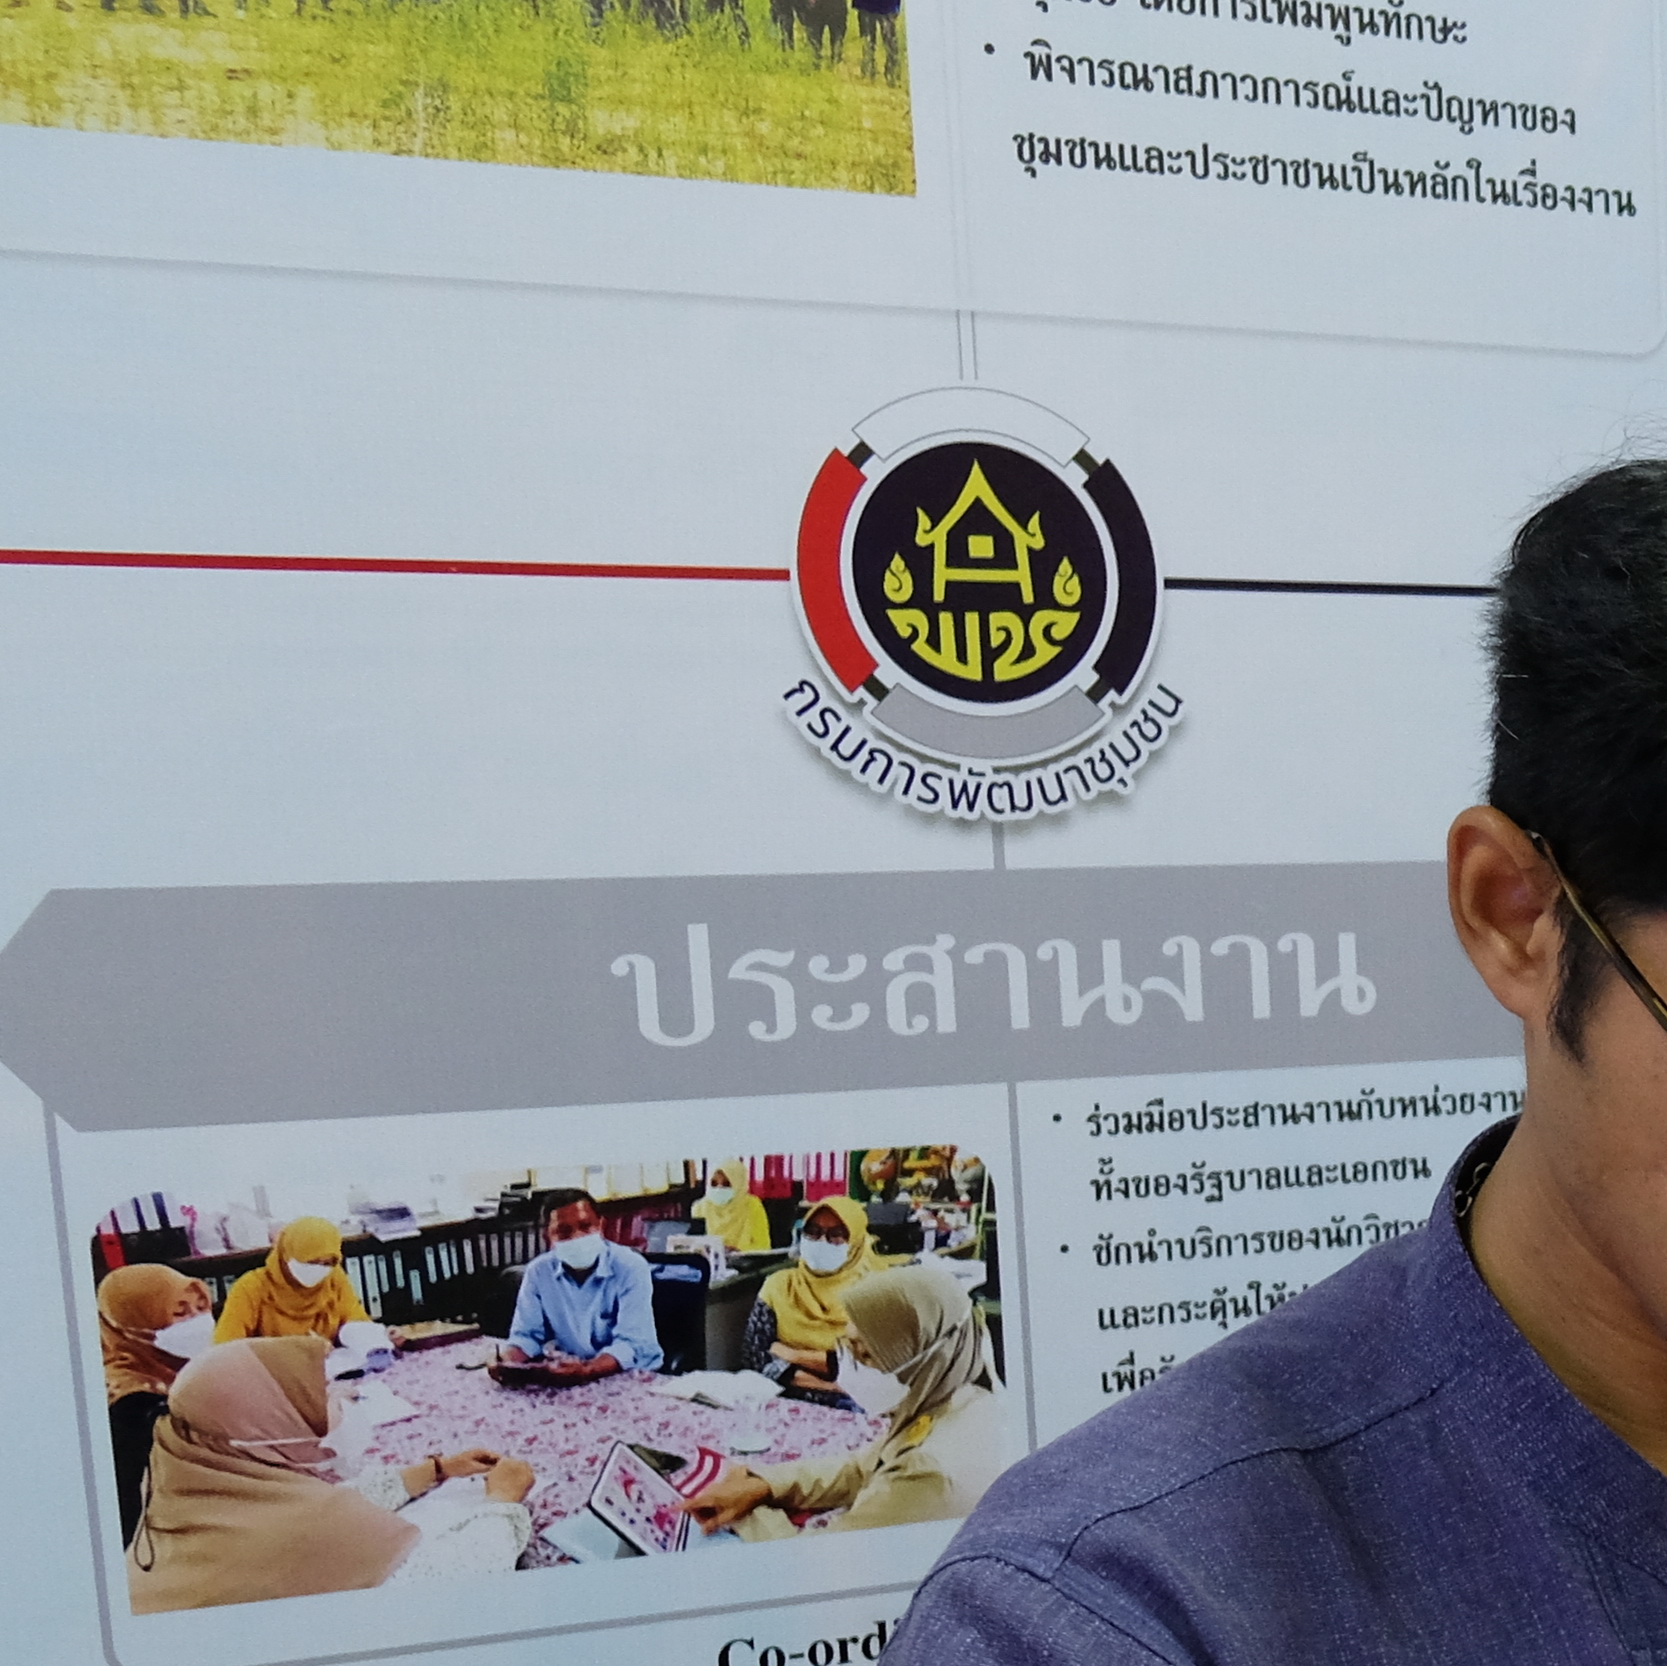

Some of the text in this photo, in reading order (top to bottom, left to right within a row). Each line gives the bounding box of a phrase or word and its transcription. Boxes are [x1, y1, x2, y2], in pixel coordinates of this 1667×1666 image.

[1022, 37, 1577, 135] พิจารณาสภาวการณ์และปัญหาของ
[1012, 131, 1637, 218] ชุมชนและประชาชนเป็นหลักในเรื่องงาน
[783, 678, 1184, 816] กรมการพัฒนาชุมชน
[611, 922, 1377, 1047] ประสานงาน
[1089, 1154, 1432, 1203] ทั้งของรัฐบาลและเอกชน
